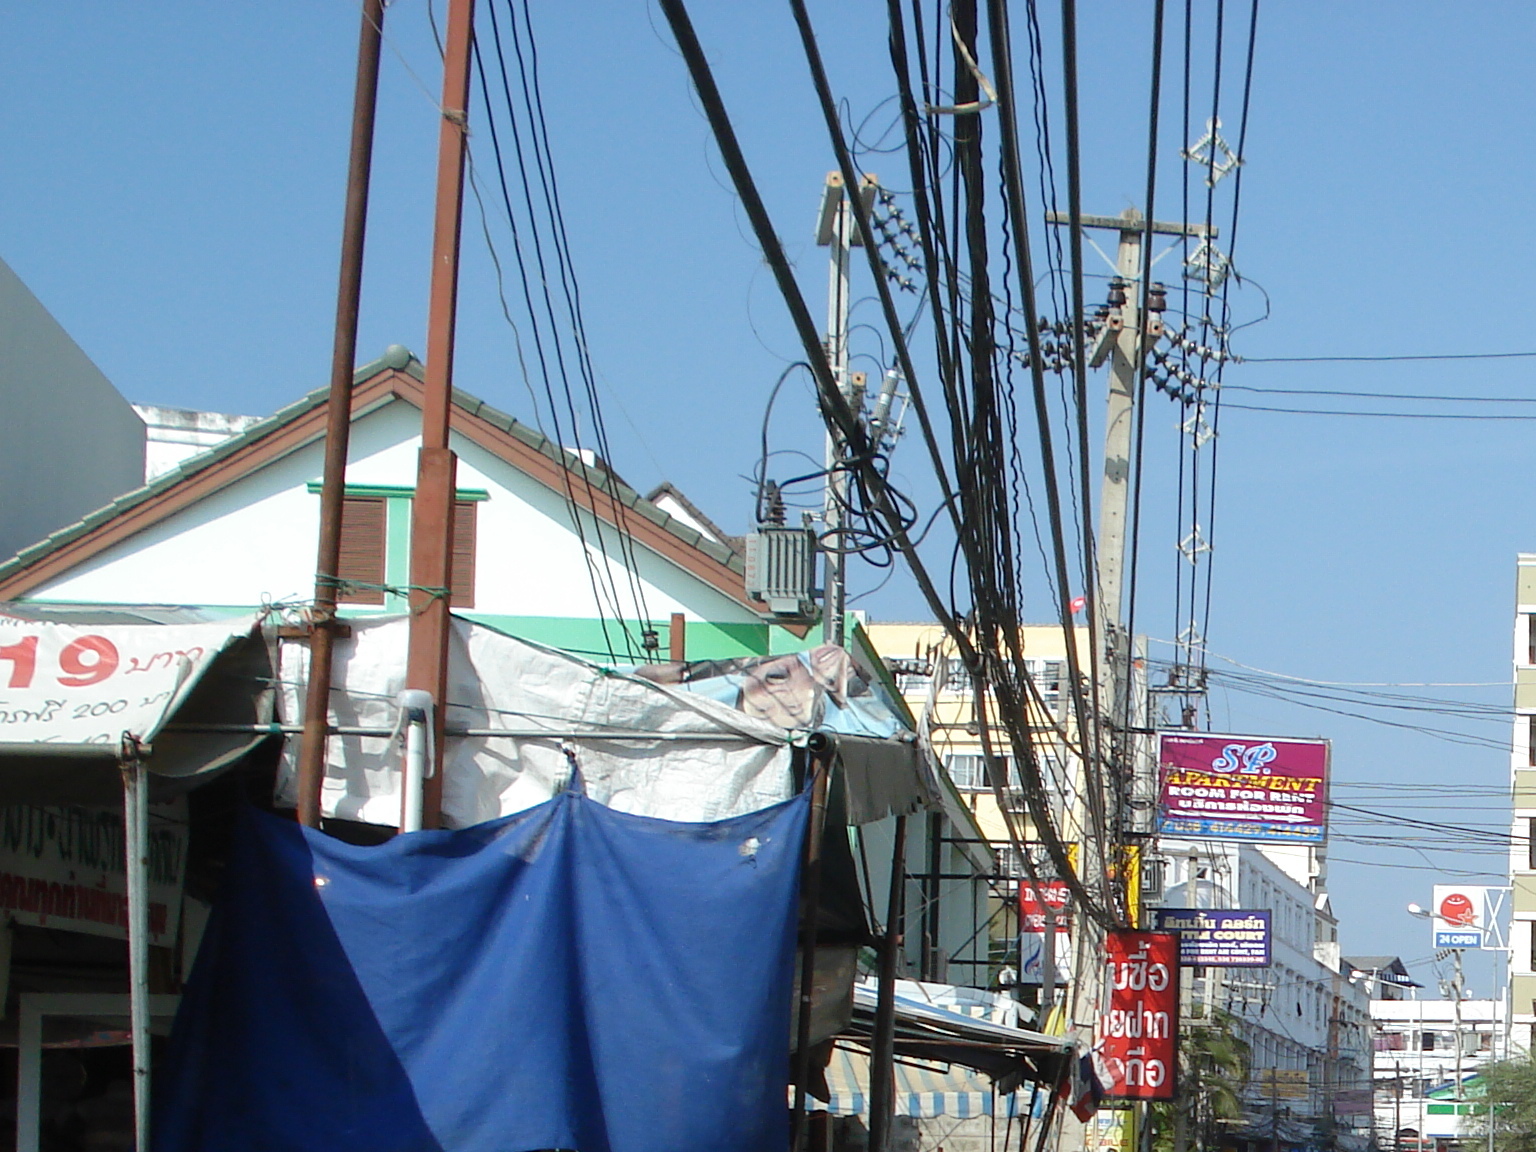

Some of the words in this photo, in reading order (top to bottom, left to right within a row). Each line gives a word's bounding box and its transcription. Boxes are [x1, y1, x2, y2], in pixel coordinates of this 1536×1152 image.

[72, 700, 128, 719] 200
[1167, 771, 1322, 792] APARTMENT
[1168, 786, 1226, 799] ROOM
[1230, 789, 1265, 801] FOR
[1270, 792, 1315, 803] RENT
[1213, 931, 1265, 940] COURT
[1451, 935, 1477, 945] OPEN
